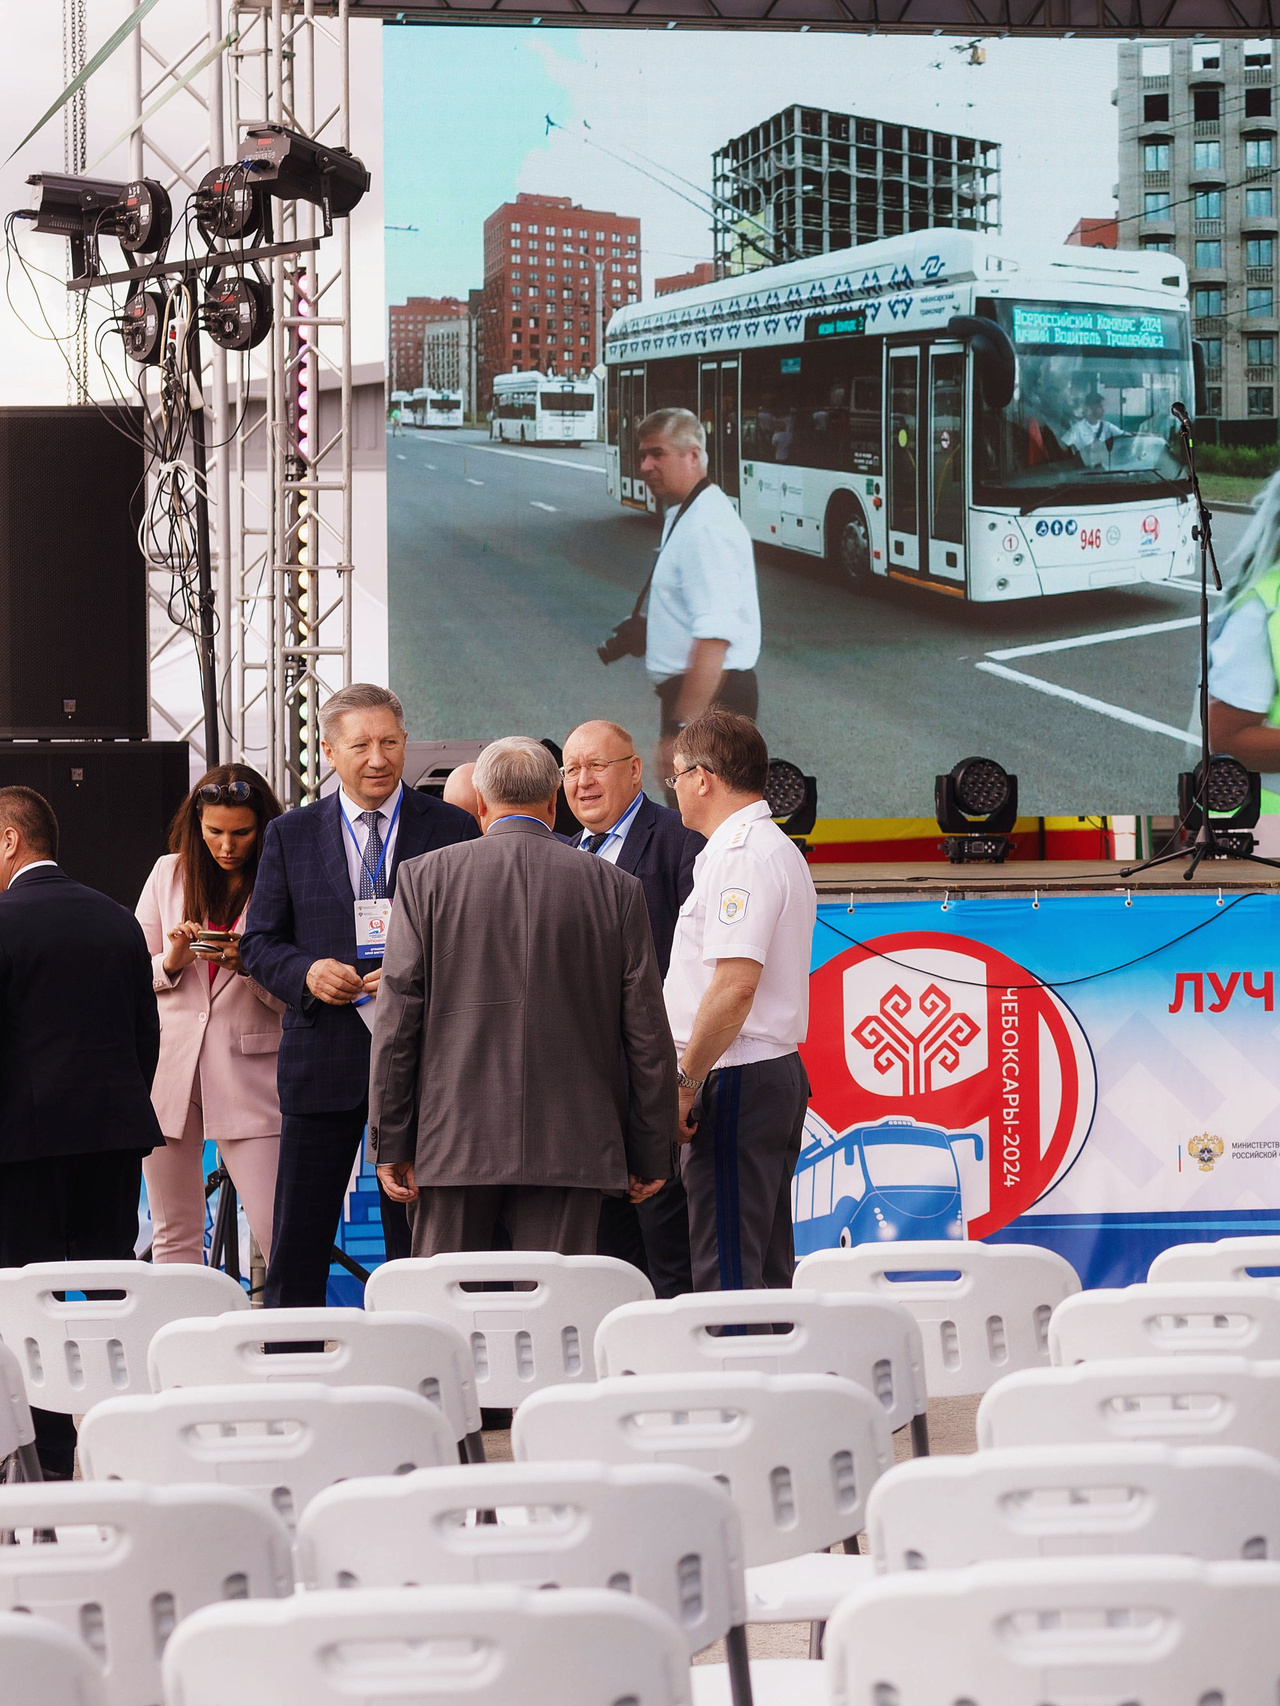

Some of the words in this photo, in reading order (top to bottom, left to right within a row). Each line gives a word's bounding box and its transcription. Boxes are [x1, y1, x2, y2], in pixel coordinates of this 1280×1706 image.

[1014, 309, 1093, 329] Всероссийский
[1097, 314, 1136, 332] Конкурс
[1140, 316, 1161, 333] 2024
[1054, 328, 1101, 345] Водитель
[1080, 528, 1101, 550] 946
[1001, 987, 1020, 1188] ЧЕБОКСАРЫ-2024
[1231, 1150, 1278, 1160] РОССИЙСКОЙ
